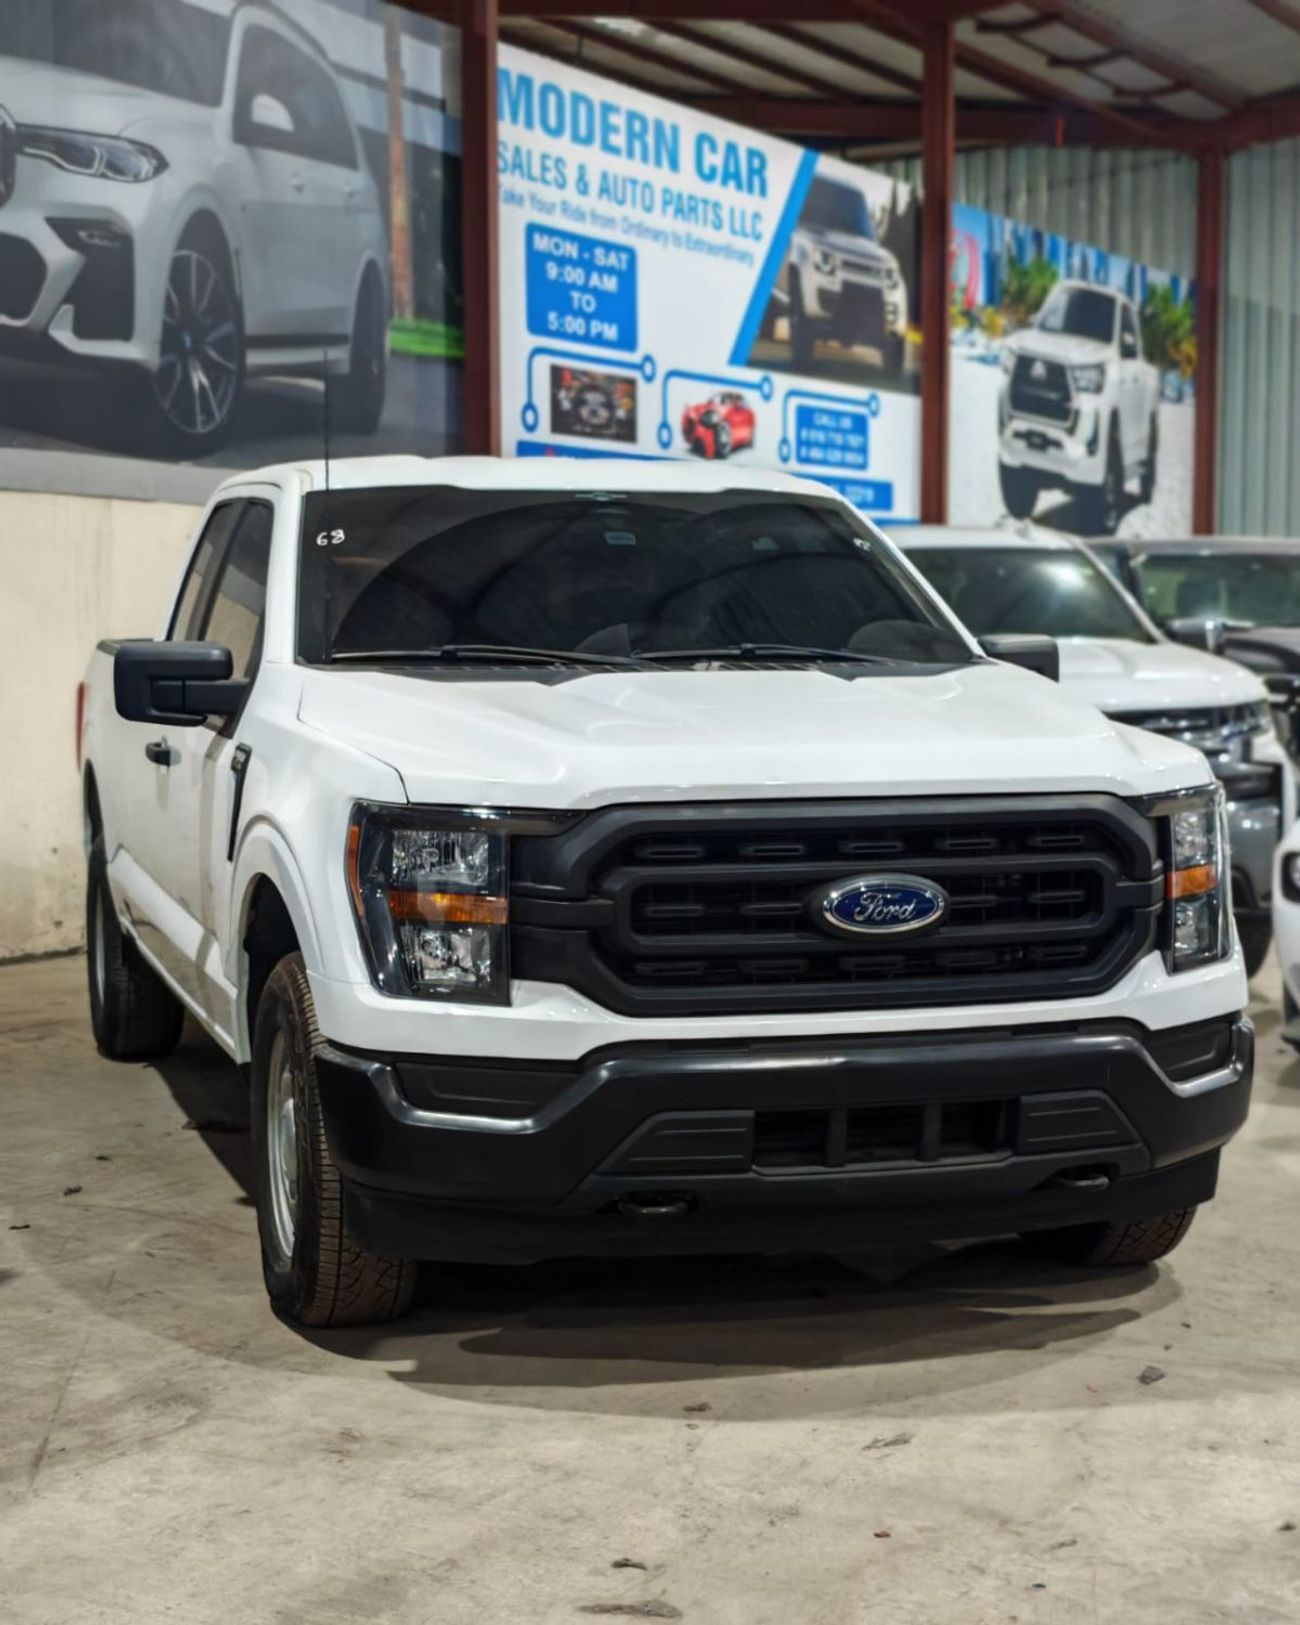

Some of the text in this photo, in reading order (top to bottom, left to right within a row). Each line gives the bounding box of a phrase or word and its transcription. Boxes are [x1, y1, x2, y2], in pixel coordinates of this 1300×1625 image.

[496, 67, 767, 198] MODERN CAR
[496, 140, 763, 242] SALES & AUTO PARTS LLC
[528, 189, 556, 216] Your
[560, 198, 587, 222] Ride
[589, 207, 617, 228] from
[620, 214, 670, 251] Ordinary
[671, 231, 682, 249] to
[685, 231, 755, 270] Extraordinary
[533, 232, 579, 260] MON
[594, 246, 629, 271] SAT
[546, 260, 619, 293] 9:00 AM
[569, 289, 597, 314] TO
[547, 310, 618, 341] 5:00 PM
[316, 528, 346, 546] 68
[853, 892, 917, 921] Ford
